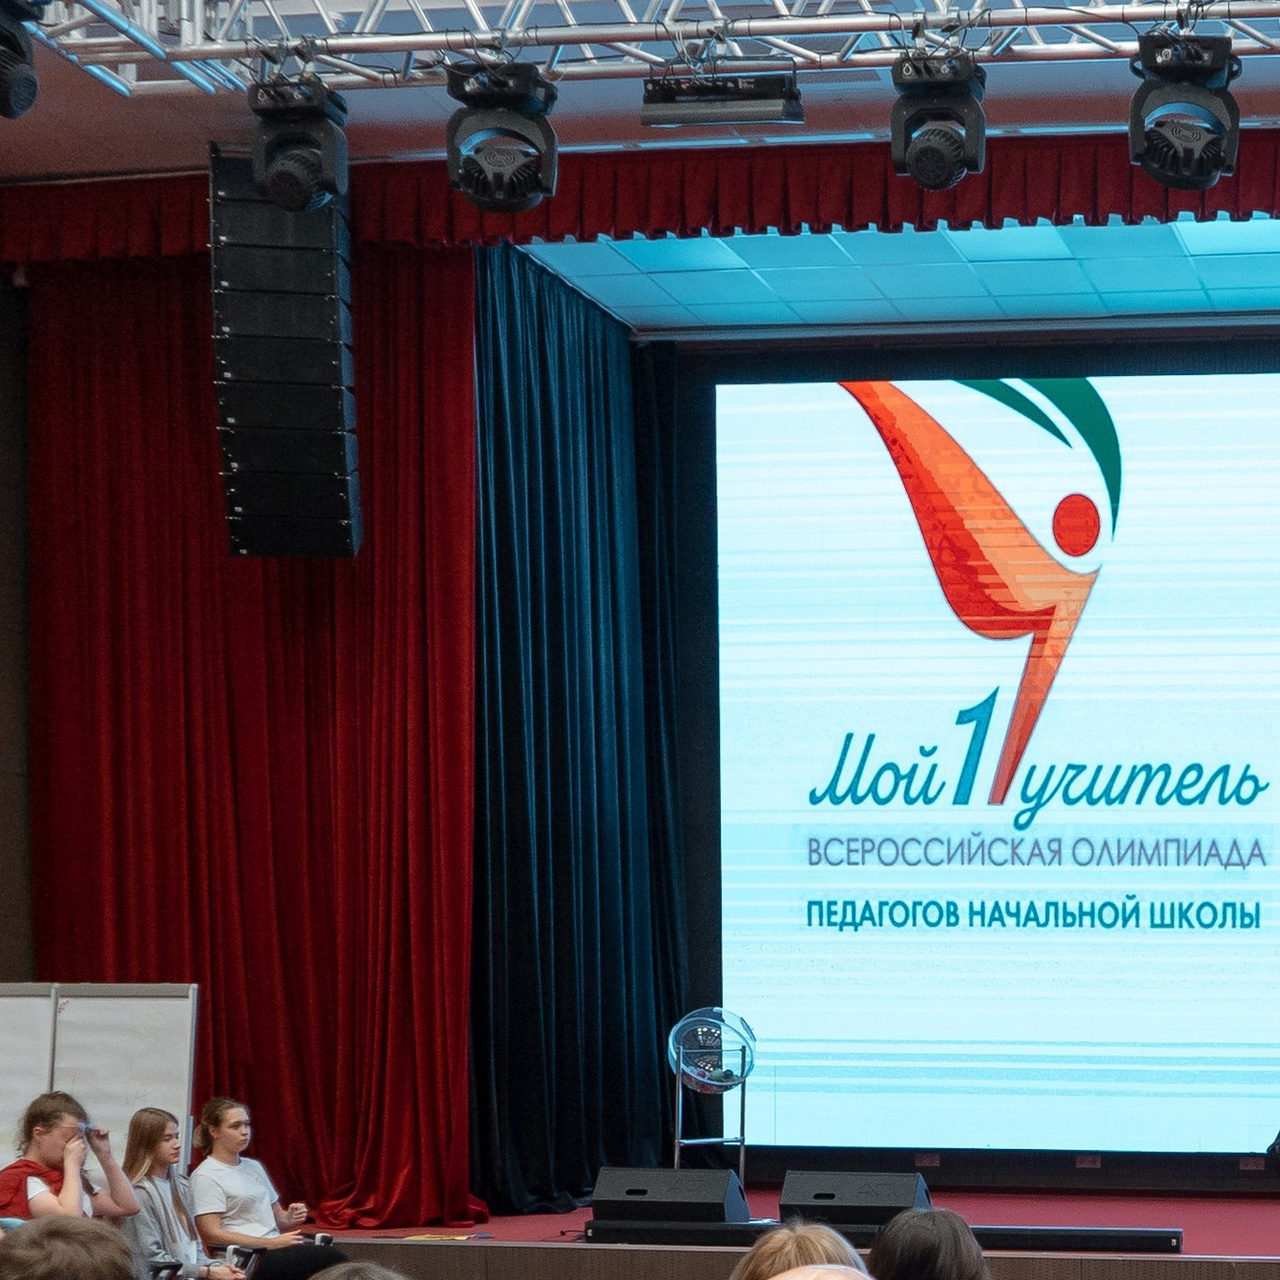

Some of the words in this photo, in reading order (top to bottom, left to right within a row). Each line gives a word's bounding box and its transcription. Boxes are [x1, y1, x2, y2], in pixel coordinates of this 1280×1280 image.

[808, 733, 946, 806] Мой
[1012, 761, 1270, 831] учитель
[808, 831, 1062, 867] ВСЕРОССИЙСКАЯ
[1071, 837, 1267, 870] ОЛИМПИАДА
[806, 901, 960, 932] ПЕДАГОГОВ
[967, 894, 1141, 929] НАЧАЛЬНОЙ
[1149, 901, 1261, 929] ШКОЛЫ
